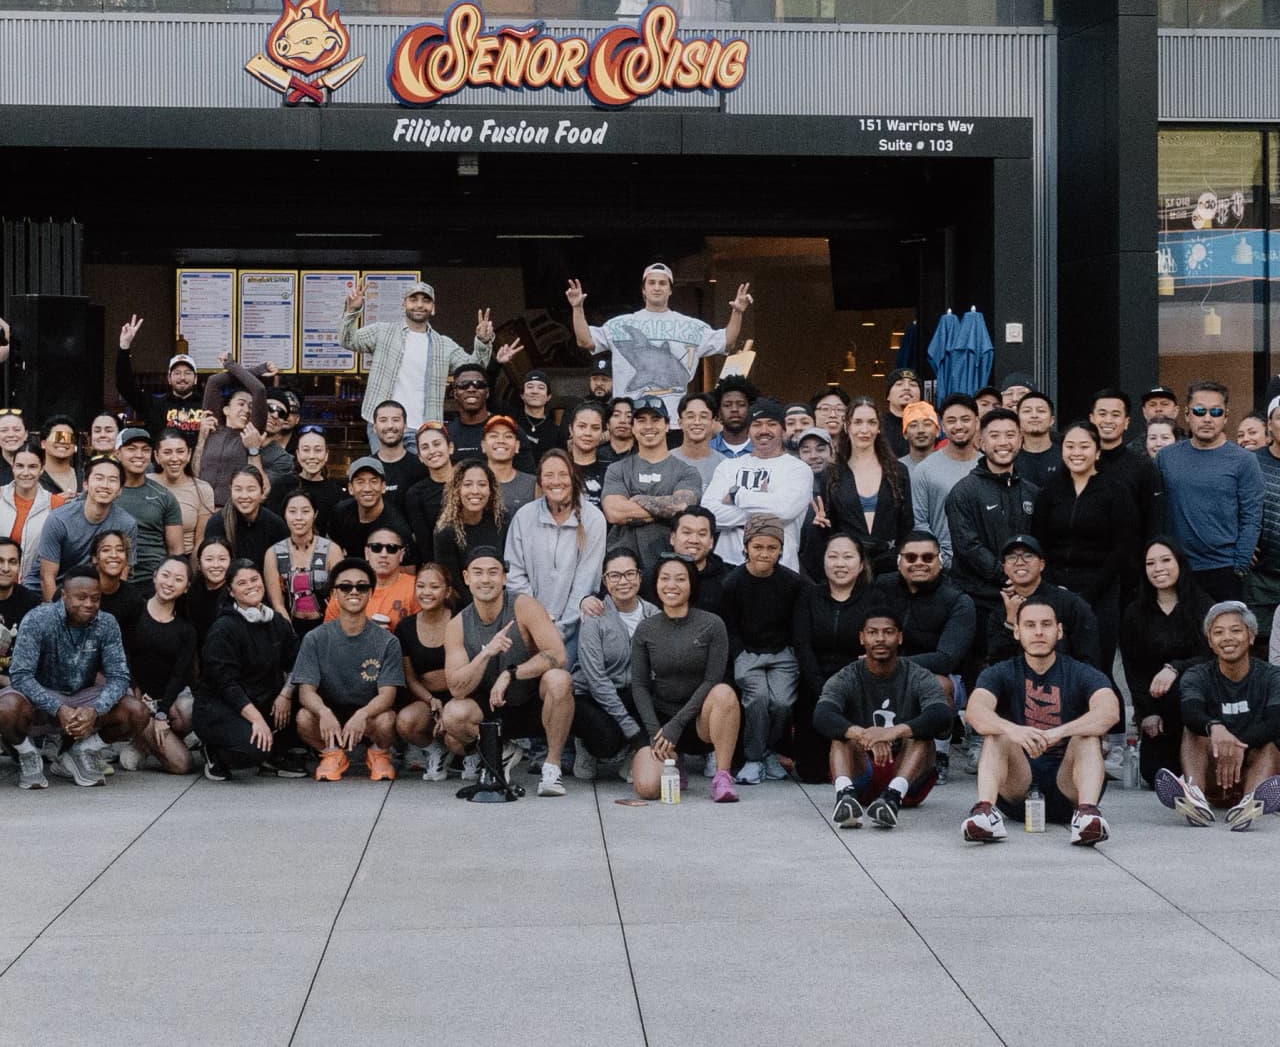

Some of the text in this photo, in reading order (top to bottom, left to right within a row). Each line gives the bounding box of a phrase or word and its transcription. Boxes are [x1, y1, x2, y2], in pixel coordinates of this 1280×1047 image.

[392, 118, 609, 147] Filipino Fusion Food
[859, 119, 975, 135] 151 Warriors Way
[879, 139, 913, 151] Suite
[929, 139, 954, 152] 103
